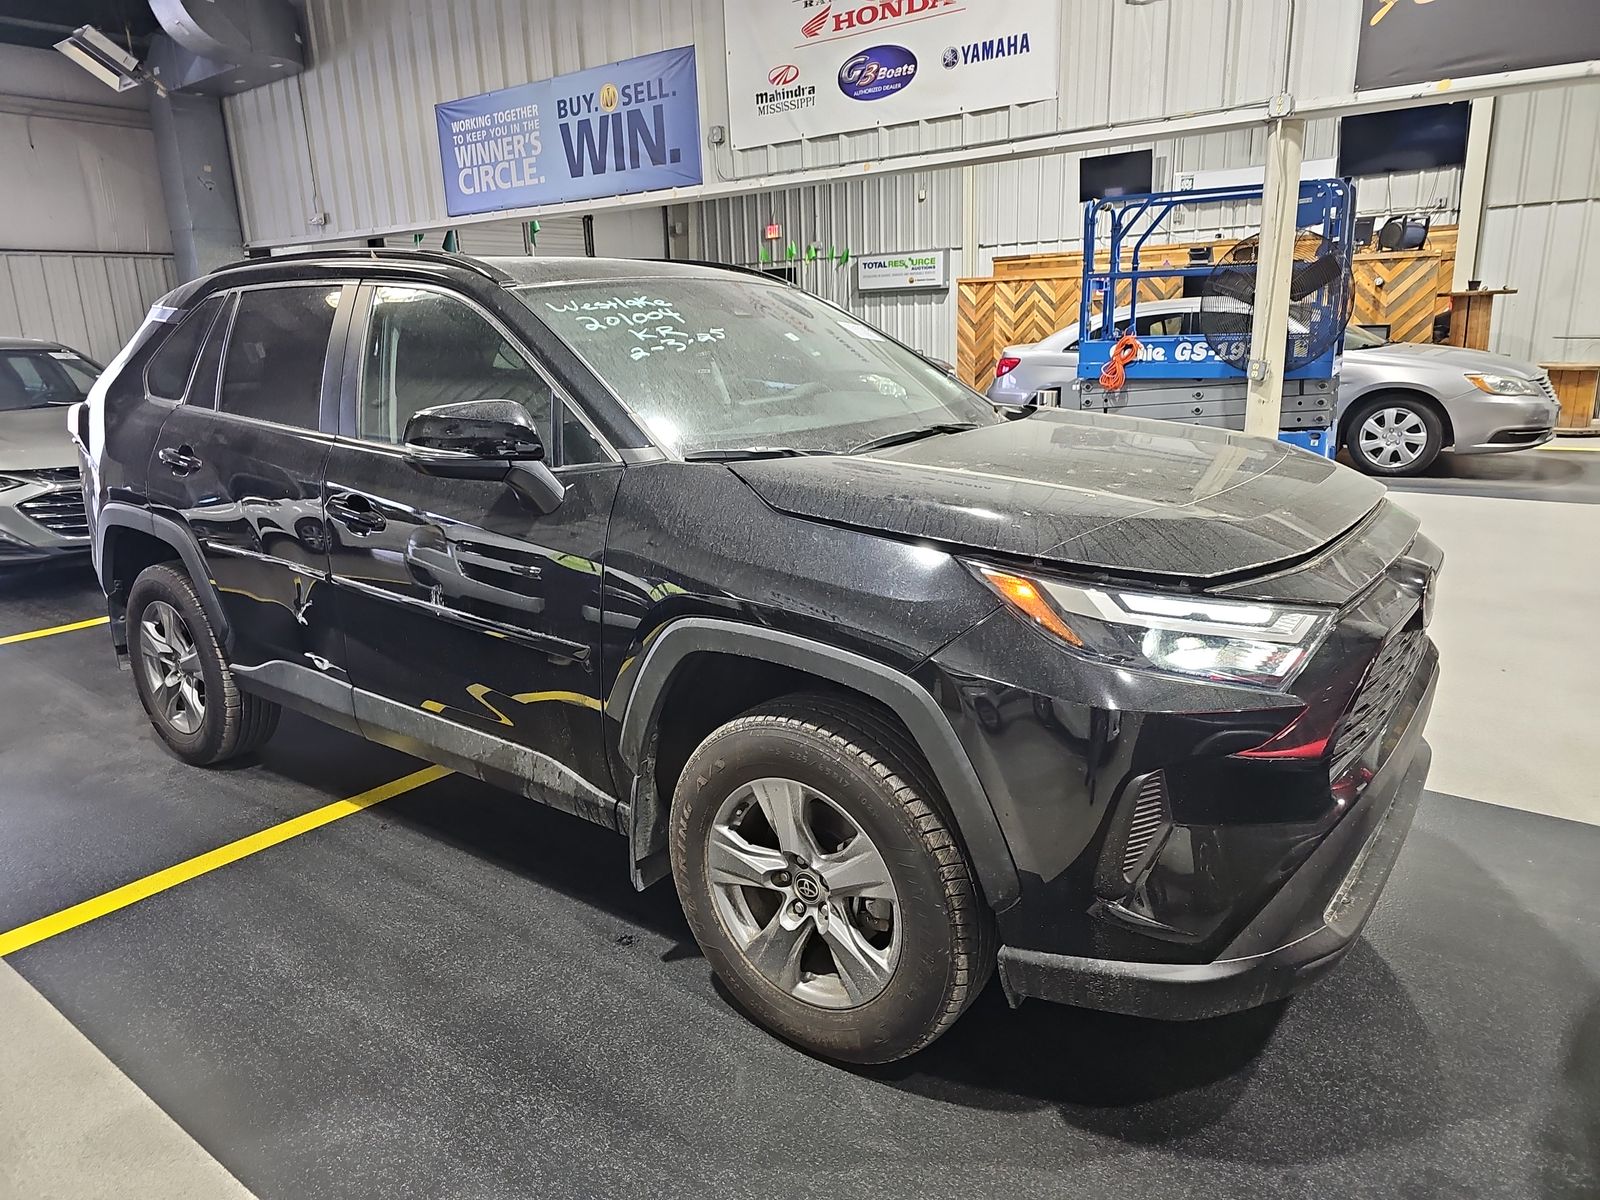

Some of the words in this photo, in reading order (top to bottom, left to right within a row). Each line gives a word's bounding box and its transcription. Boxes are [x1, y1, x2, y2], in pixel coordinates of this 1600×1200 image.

[962, 32, 1031, 65] YAMAHA
[877, 63, 915, 80] Boats
[557, 92, 599, 119] BUY.
[621, 78, 677, 106] SELL.
[755, 84, 816, 105] Mahindra
[853, 85, 883, 97] AUTHORIZED
[883, 82, 902, 92] DEALER
[758, 96, 815, 117] MISSISSIPPI
[451, 114, 491, 134] WORKING
[493, 104, 539, 125] TOGETHER
[453, 134, 464, 146] TO
[466, 129, 487, 143] KEEP
[489, 125, 508, 138] YOU
[511, 123, 520, 134] IN
[523, 119, 540, 132] THE
[559, 104, 681, 178] WIN.
[454, 131, 542, 169] WINNER'S
[458, 156, 546, 195] CIRCLE.
[862, 261, 887, 270] TOTAL
[545, 295, 673, 313] Westlake
[575, 308, 686, 332] 201004
[1174, 341, 1251, 362] GS-19
